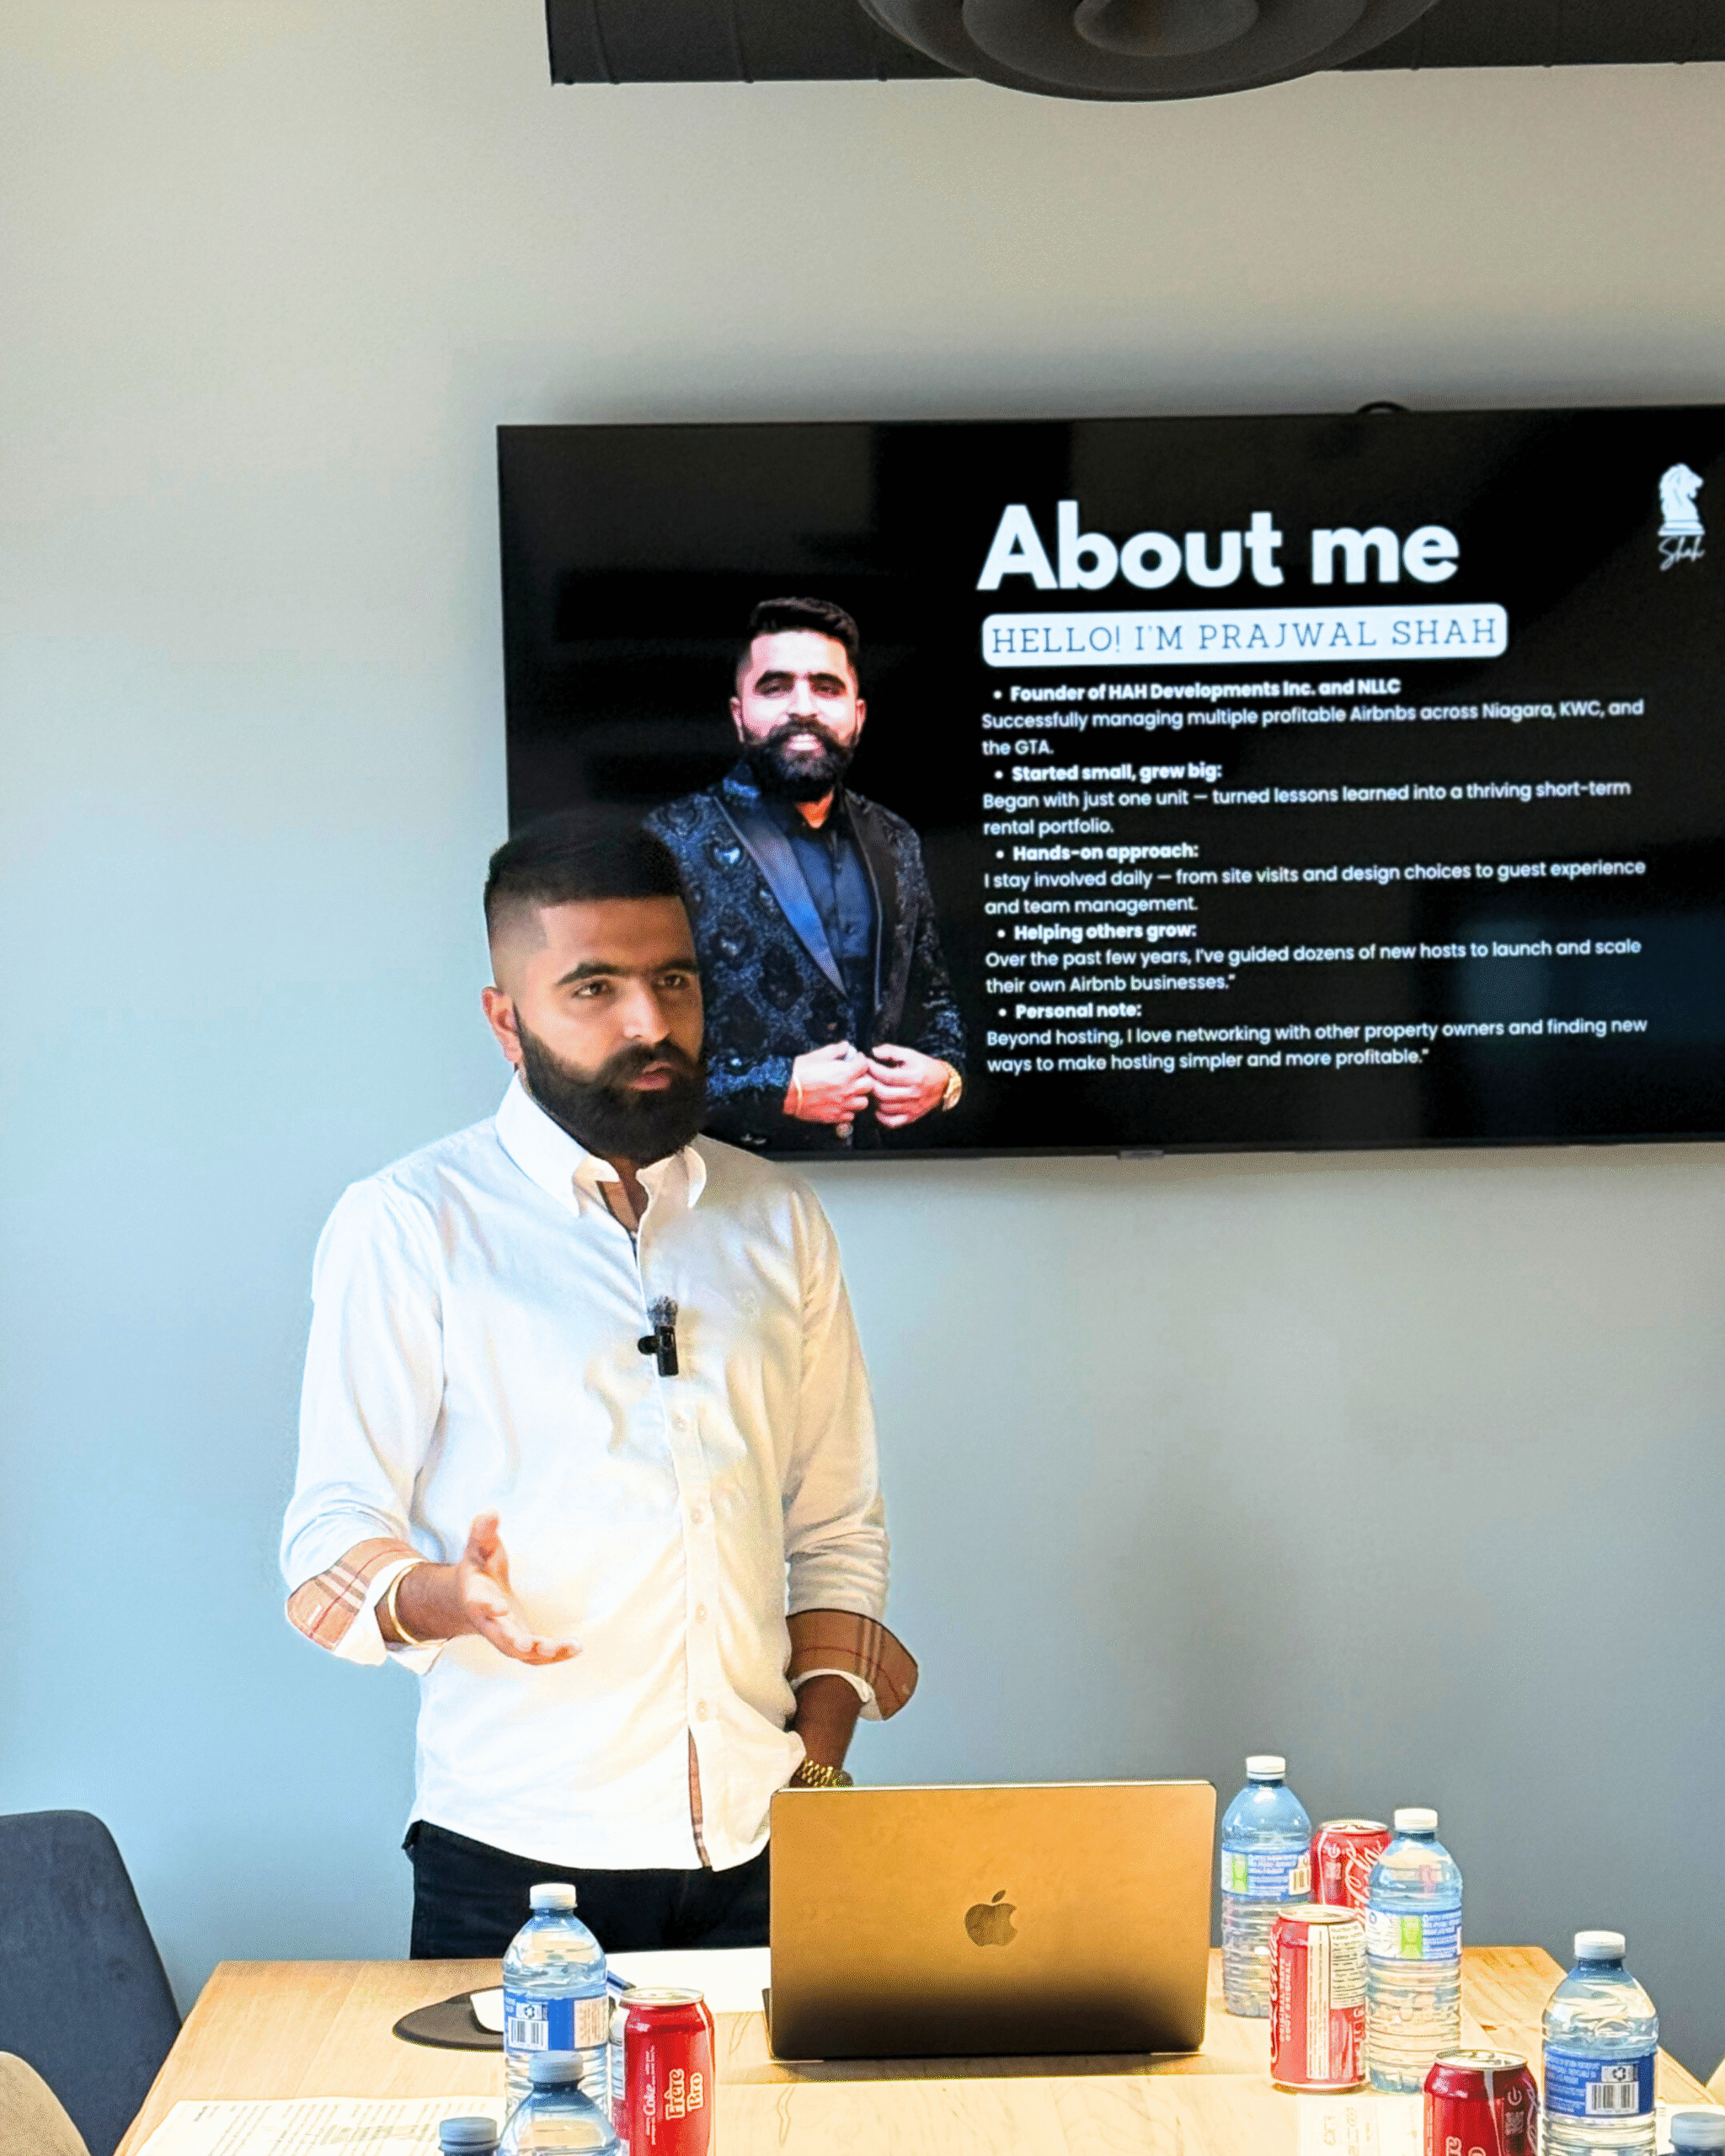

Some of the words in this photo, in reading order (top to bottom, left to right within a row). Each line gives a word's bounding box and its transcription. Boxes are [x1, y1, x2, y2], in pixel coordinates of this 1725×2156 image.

[977, 500, 1284, 590] About
[1312, 526, 1459, 584] me
[993, 626, 1119, 653] HELLO!
[1135, 626, 1183, 650] I'M
[1199, 622, 1376, 649] PRAJWAL
[1392, 619, 1494, 645] SHAH
[1011, 685, 1086, 702] Founder
[1087, 683, 1107, 701] of
[1108, 683, 1148, 700] HAH
[1150, 681, 1280, 702] Developments
[1283, 680, 1316, 696] Inc.
[1318, 678, 1355, 696] and
[1357, 678, 1401, 696] NLLC
[981, 712, 1089, 732] Successfully
[1092, 709, 1183, 731] managing
[1187, 708, 1258, 728] multiple
[1261, 706, 1347, 728] profitable
[1349, 704, 1417, 722] Airbnbs
[1419, 706, 1479, 721] across
[1482, 702, 1557, 723] Niagara,
[1559, 700, 1605, 718] KWC,
[1608, 699, 1644, 716] and
[981, 739, 1012, 755] the
[1014, 739, 1055, 755] GTA.
[1012, 764, 1079, 782] Started
[1081, 763, 1136, 782] small,
[1139, 766, 1185, 784] grew
[1188, 760, 1222, 783] big:
[982, 792, 1040, 814] Began
[1042, 792, 1081, 808] with
[1082, 791, 1115, 812] just
[1118, 792, 1152, 807] one
[1155, 789, 1189, 806] unit
[1211, 787, 1271, 804] turned
[1273, 787, 1339, 803] lessons
[1342, 784, 1410, 802] learned
[1413, 784, 1447, 800] into
[1449, 786, 1464, 800] a
[1466, 782, 1533, 803] thriving
[1535, 781, 1632, 798] short-term
[983, 819, 1034, 835] rental
[1038, 817, 1114, 839] portfolio.
[1012, 844, 1104, 862] Hands-on
[1105, 841, 1199, 864] approach:
[984, 873, 990, 889] I
[993, 873, 1031, 892] stay
[1033, 870, 1107, 888] involved
[1110, 869, 1153, 889] daily
[1175, 868, 1218, 885] from
[1221, 867, 1252, 884] site
[1255, 867, 1299, 883] visits
[1302, 866, 1338, 883] and
[1341, 864, 1401, 885] design
[1403, 862, 1471, 880] choices
[1475, 863, 1494, 878] to
[1497, 862, 1546, 883] guest
[1549, 860, 1646, 880] experience
[984, 898, 1020, 915] and
[1023, 899, 1071, 914] team
[1074, 896, 1199, 917] management.
[1014, 923, 1083, 945] Helping
[1086, 922, 1144, 940] others
[1146, 924, 1197, 943] grow:
[985, 952, 1027, 968] Over
[1029, 951, 1060, 967] the
[1062, 950, 1102, 970] past
[1105, 948, 1137, 965] few
[1140, 951, 1192, 969] years,
[1195, 948, 1225, 963] I've
[1227, 946, 1290, 968] guided
[1292, 945, 1355, 962] dozens
[1358, 943, 1376, 960] of
[1379, 946, 1417, 959] new
[1419, 942, 1466, 958] hosts
[1470, 942, 1489, 958] to
[1492, 940, 1552, 958] launch
[1555, 939, 1591, 956] and
[1594, 938, 1642, 955] scale
[985, 977, 1026, 994] their
[1028, 979, 1066, 993] own
[1069, 975, 1127, 992] Airbnb
[1015, 1001, 1093, 1019] Personal
[1096, 1002, 1141, 1018] note:
[986, 1029, 1052, 1050] Beyond
[1055, 1028, 1124, 1049] hosting,
[1127, 1028, 1132, 1043] I
[1135, 1027, 1172, 1043] love
[1175, 1025, 1271, 1045] networking
[1274, 1024, 1311, 1040] with
[1314, 1023, 1361, 1040] other
[1364, 1022, 1439, 1043] property
[1441, 1022, 1505, 1037] owners
[1508, 1019, 1544, 1036] and
[1546, 1018, 1607, 1038] finding
[1610, 1019, 1648, 1033] new
[986, 1059, 1033, 1076] ways
[1035, 1056, 1055, 1071] to
[1058, 1054, 1108, 1071] make
[1110, 1054, 1175, 1074] hosting
[1178, 1052, 1244, 1072] simpler
[1247, 1050, 1282, 1067] and
[1284, 1053, 1332, 1066] more
[643, 2084, 656, 2116] Coke
[665, 2069, 684, 2119] Frère
[687, 2073, 702, 2110] Bro
